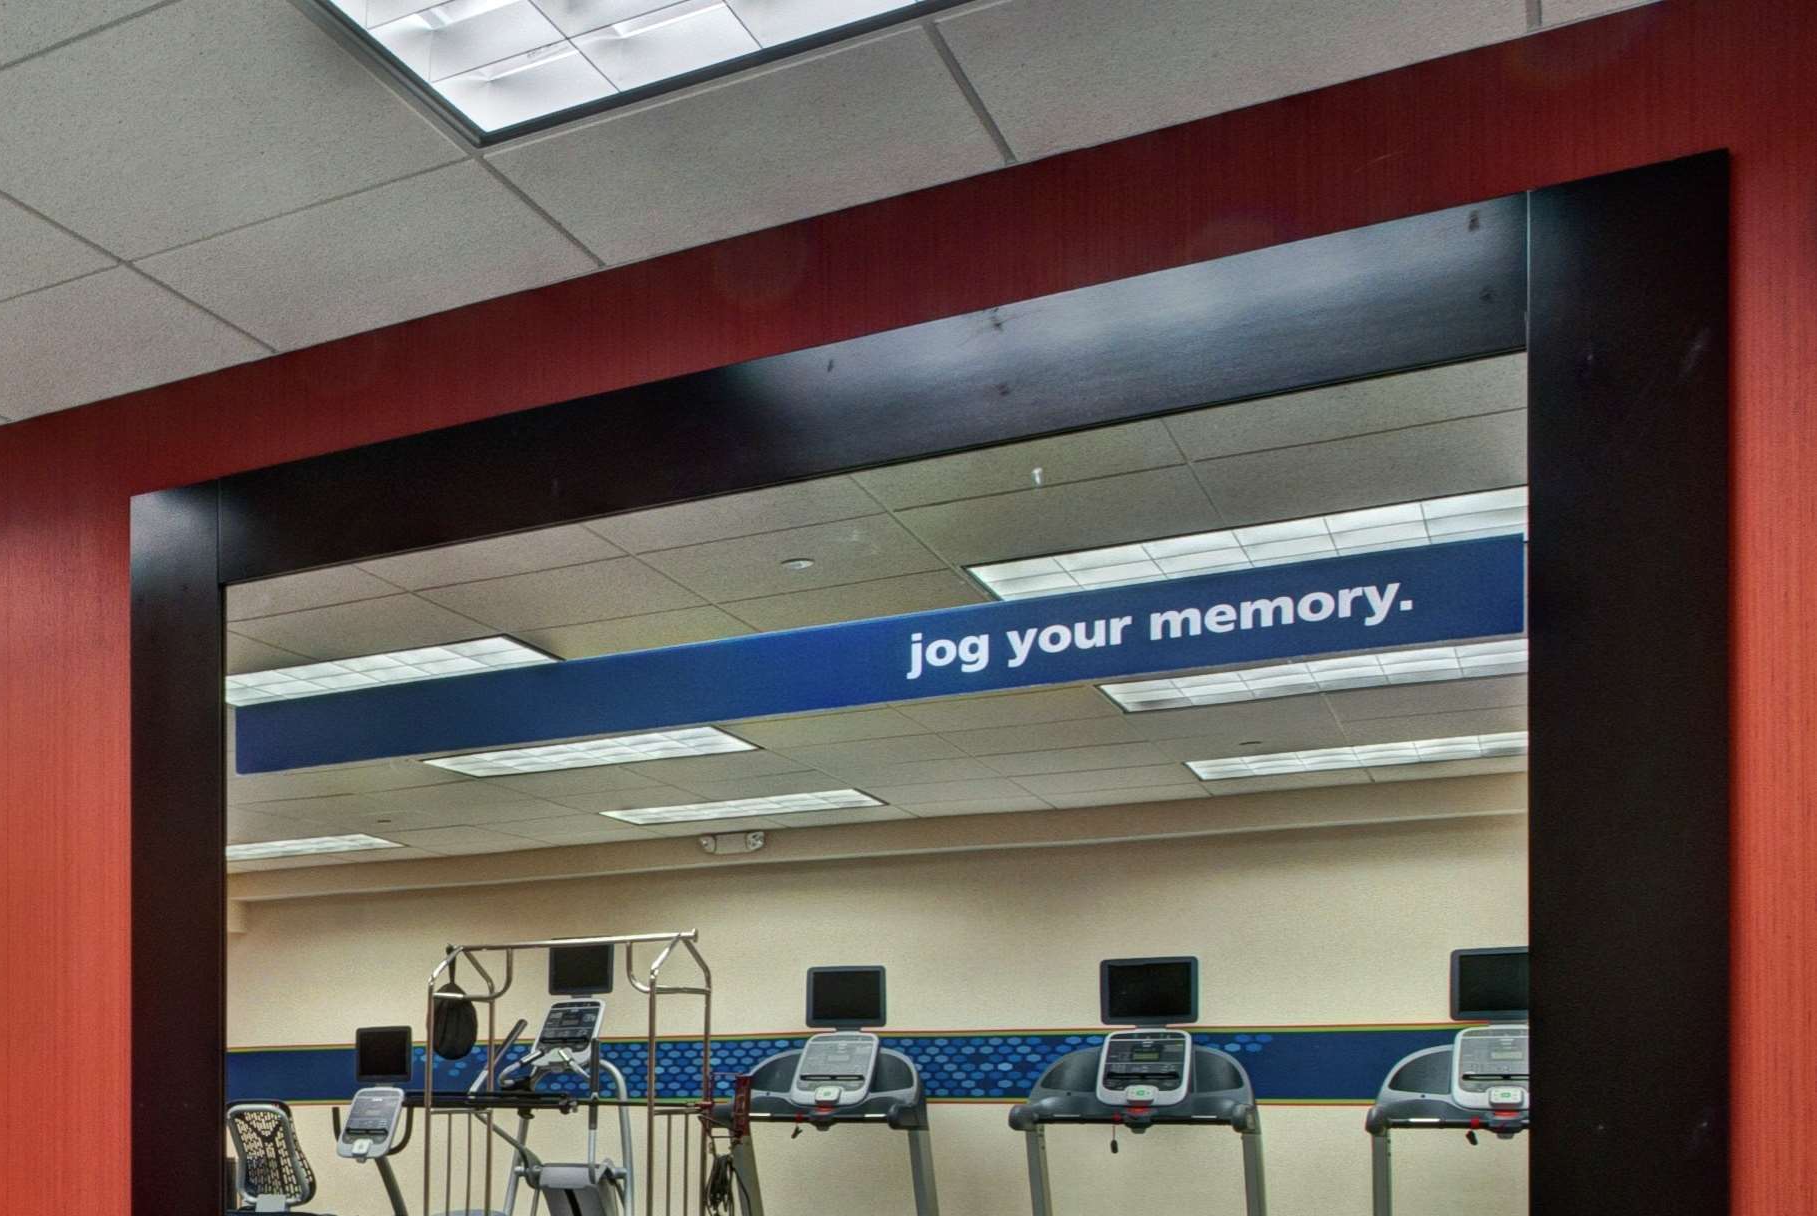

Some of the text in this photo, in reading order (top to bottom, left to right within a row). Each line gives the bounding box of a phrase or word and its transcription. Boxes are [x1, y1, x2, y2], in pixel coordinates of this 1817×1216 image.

[906, 582, 1413, 679] jog your memory.
